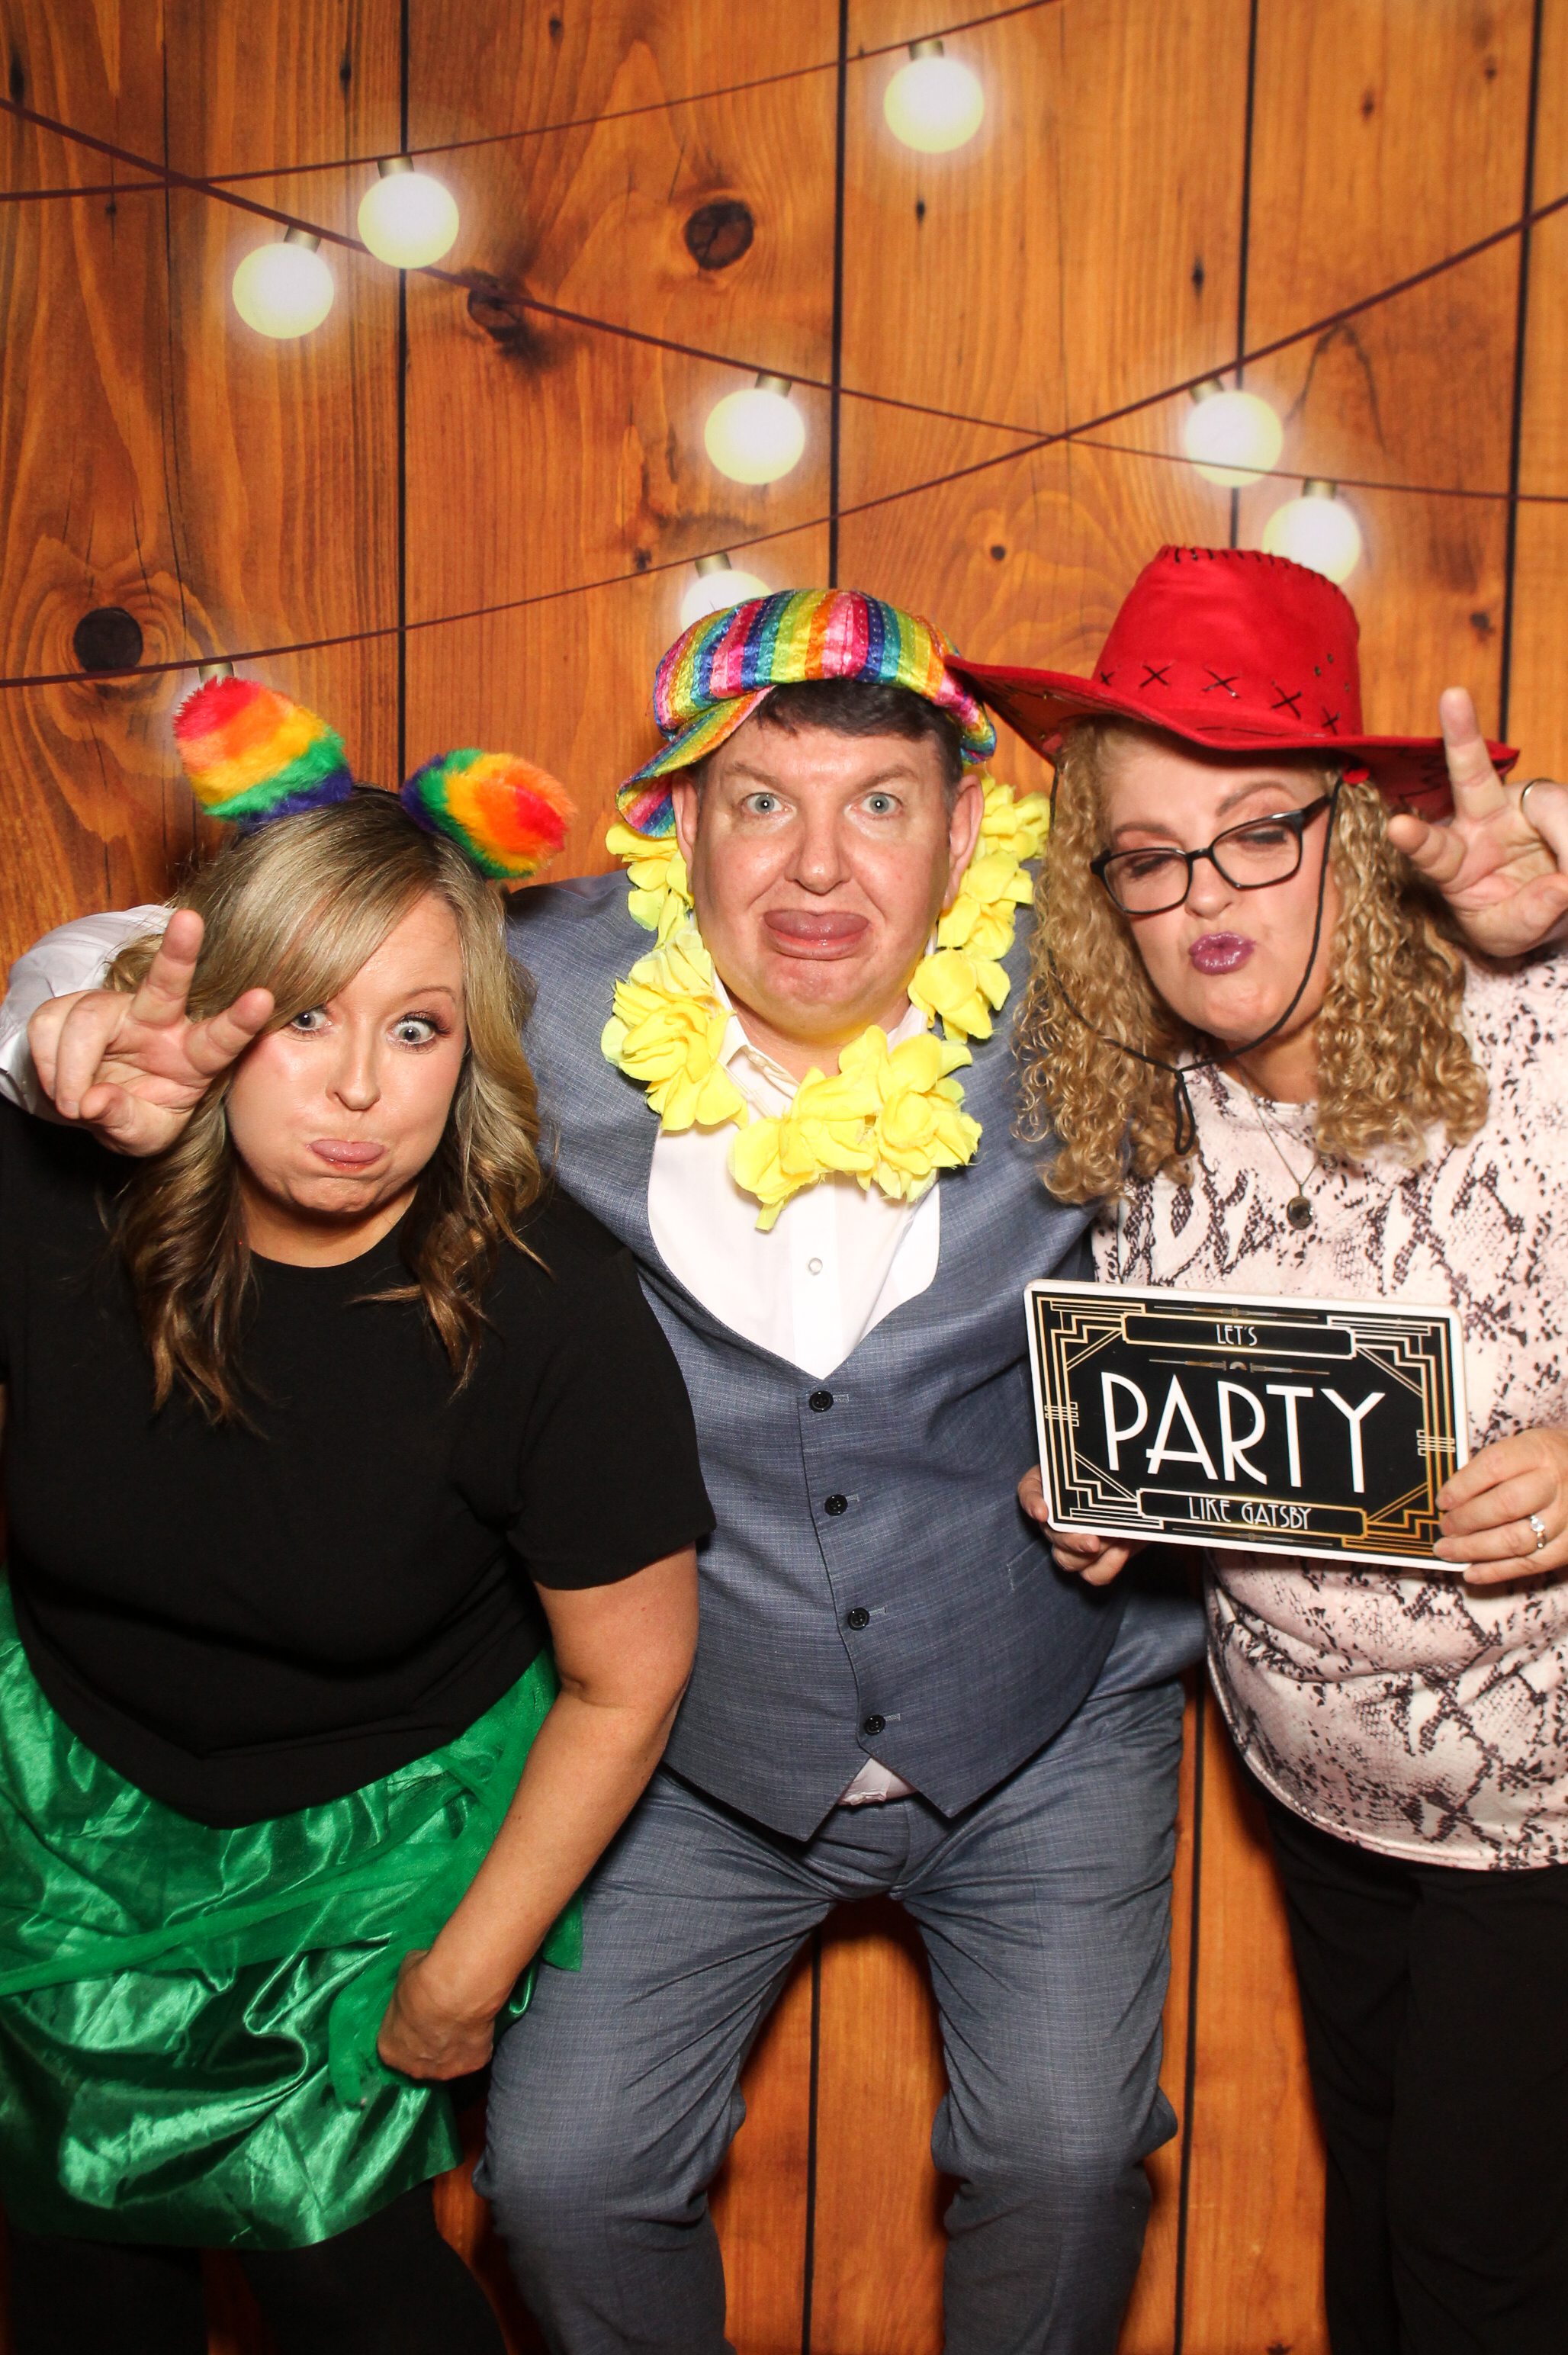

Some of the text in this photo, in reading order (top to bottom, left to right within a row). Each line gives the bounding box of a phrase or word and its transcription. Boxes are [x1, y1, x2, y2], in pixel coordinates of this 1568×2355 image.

[1216, 1324, 1258, 1346] LET'S
[1100, 1371, 1386, 1493] PARTY
[1188, 1496, 1312, 1530] LIKE GATSBY
